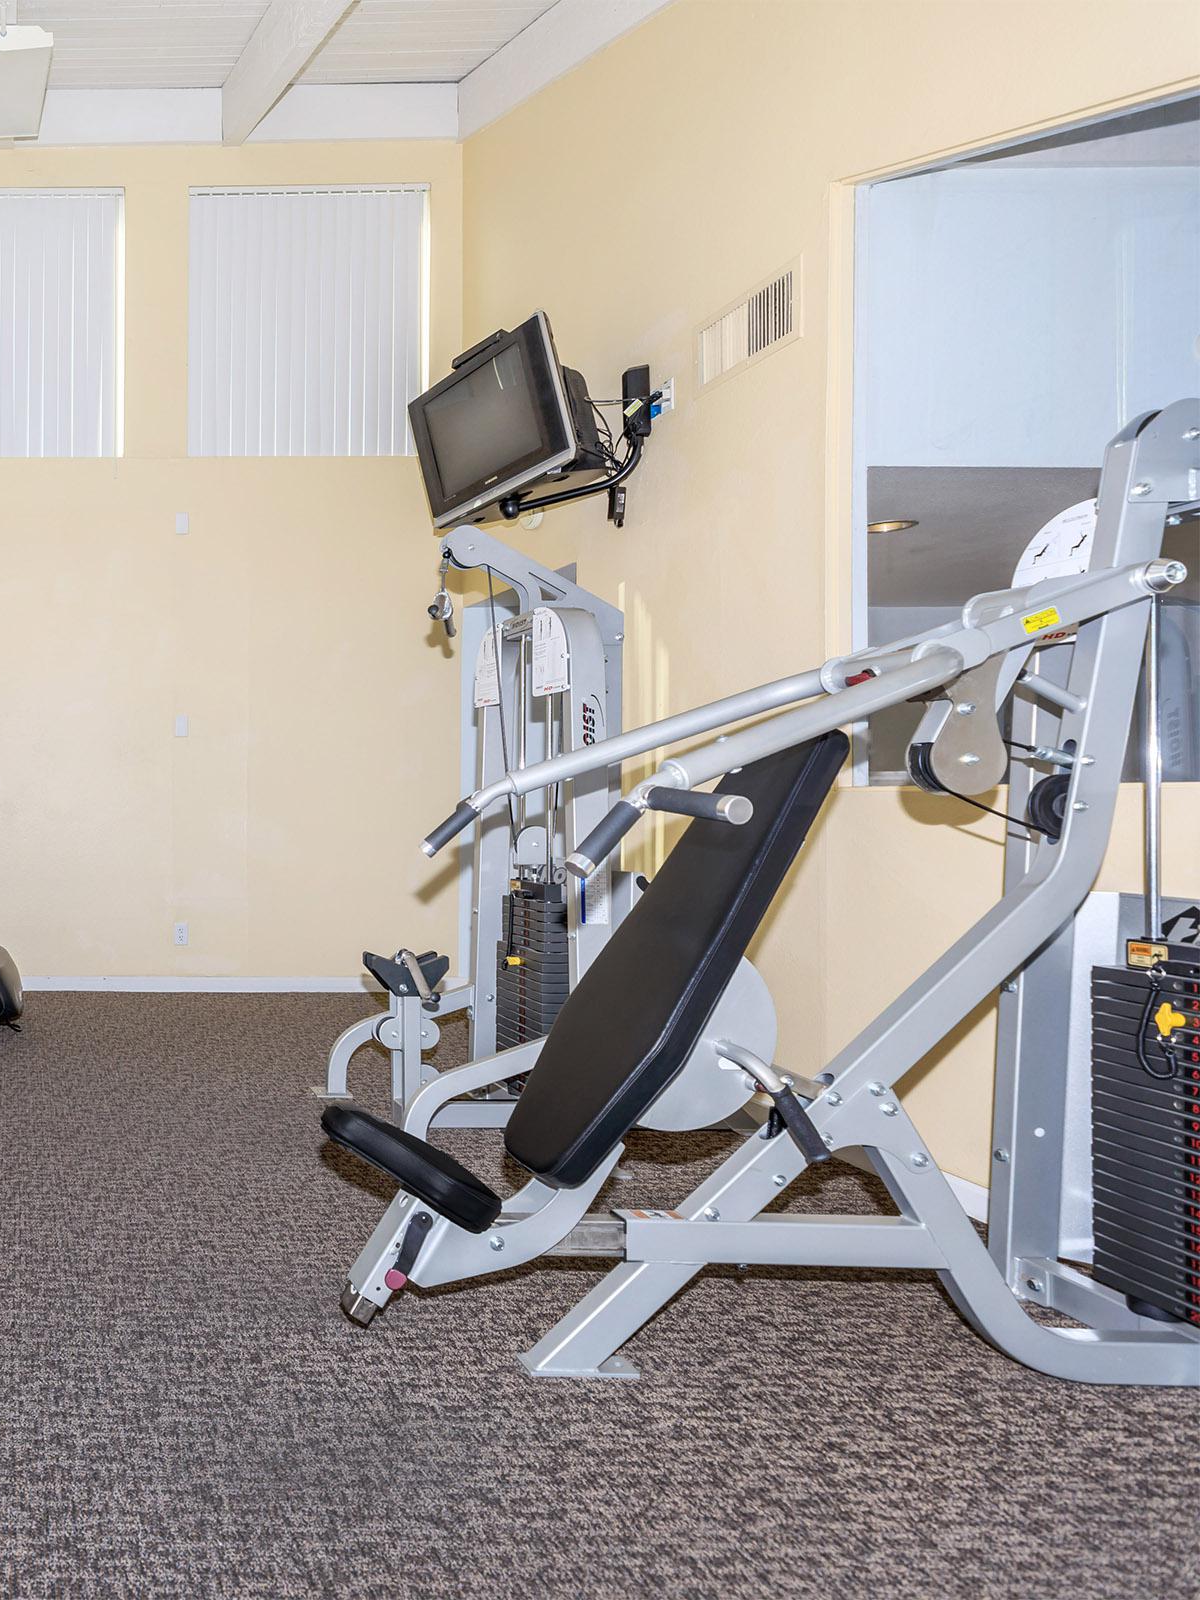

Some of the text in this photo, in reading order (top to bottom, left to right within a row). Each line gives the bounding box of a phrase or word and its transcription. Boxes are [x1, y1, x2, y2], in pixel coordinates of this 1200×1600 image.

[1043, 632, 1066, 640] HD
[583, 703, 595, 746] OIST
[1193, 983, 1198, 993] 1
[1192, 1000, 1199, 1010] 2
[1192, 1017, 1199, 1028] 3
[1191, 1035, 1199, 1044] 4
[1191, 1051, 1199, 1062] 5
[1192, 1069, 1199, 1080] 6
[1192, 1086, 1199, 1096] 7
[1192, 1104, 1200, 1114] 8
[1192, 1122, 1199, 1131] 9
